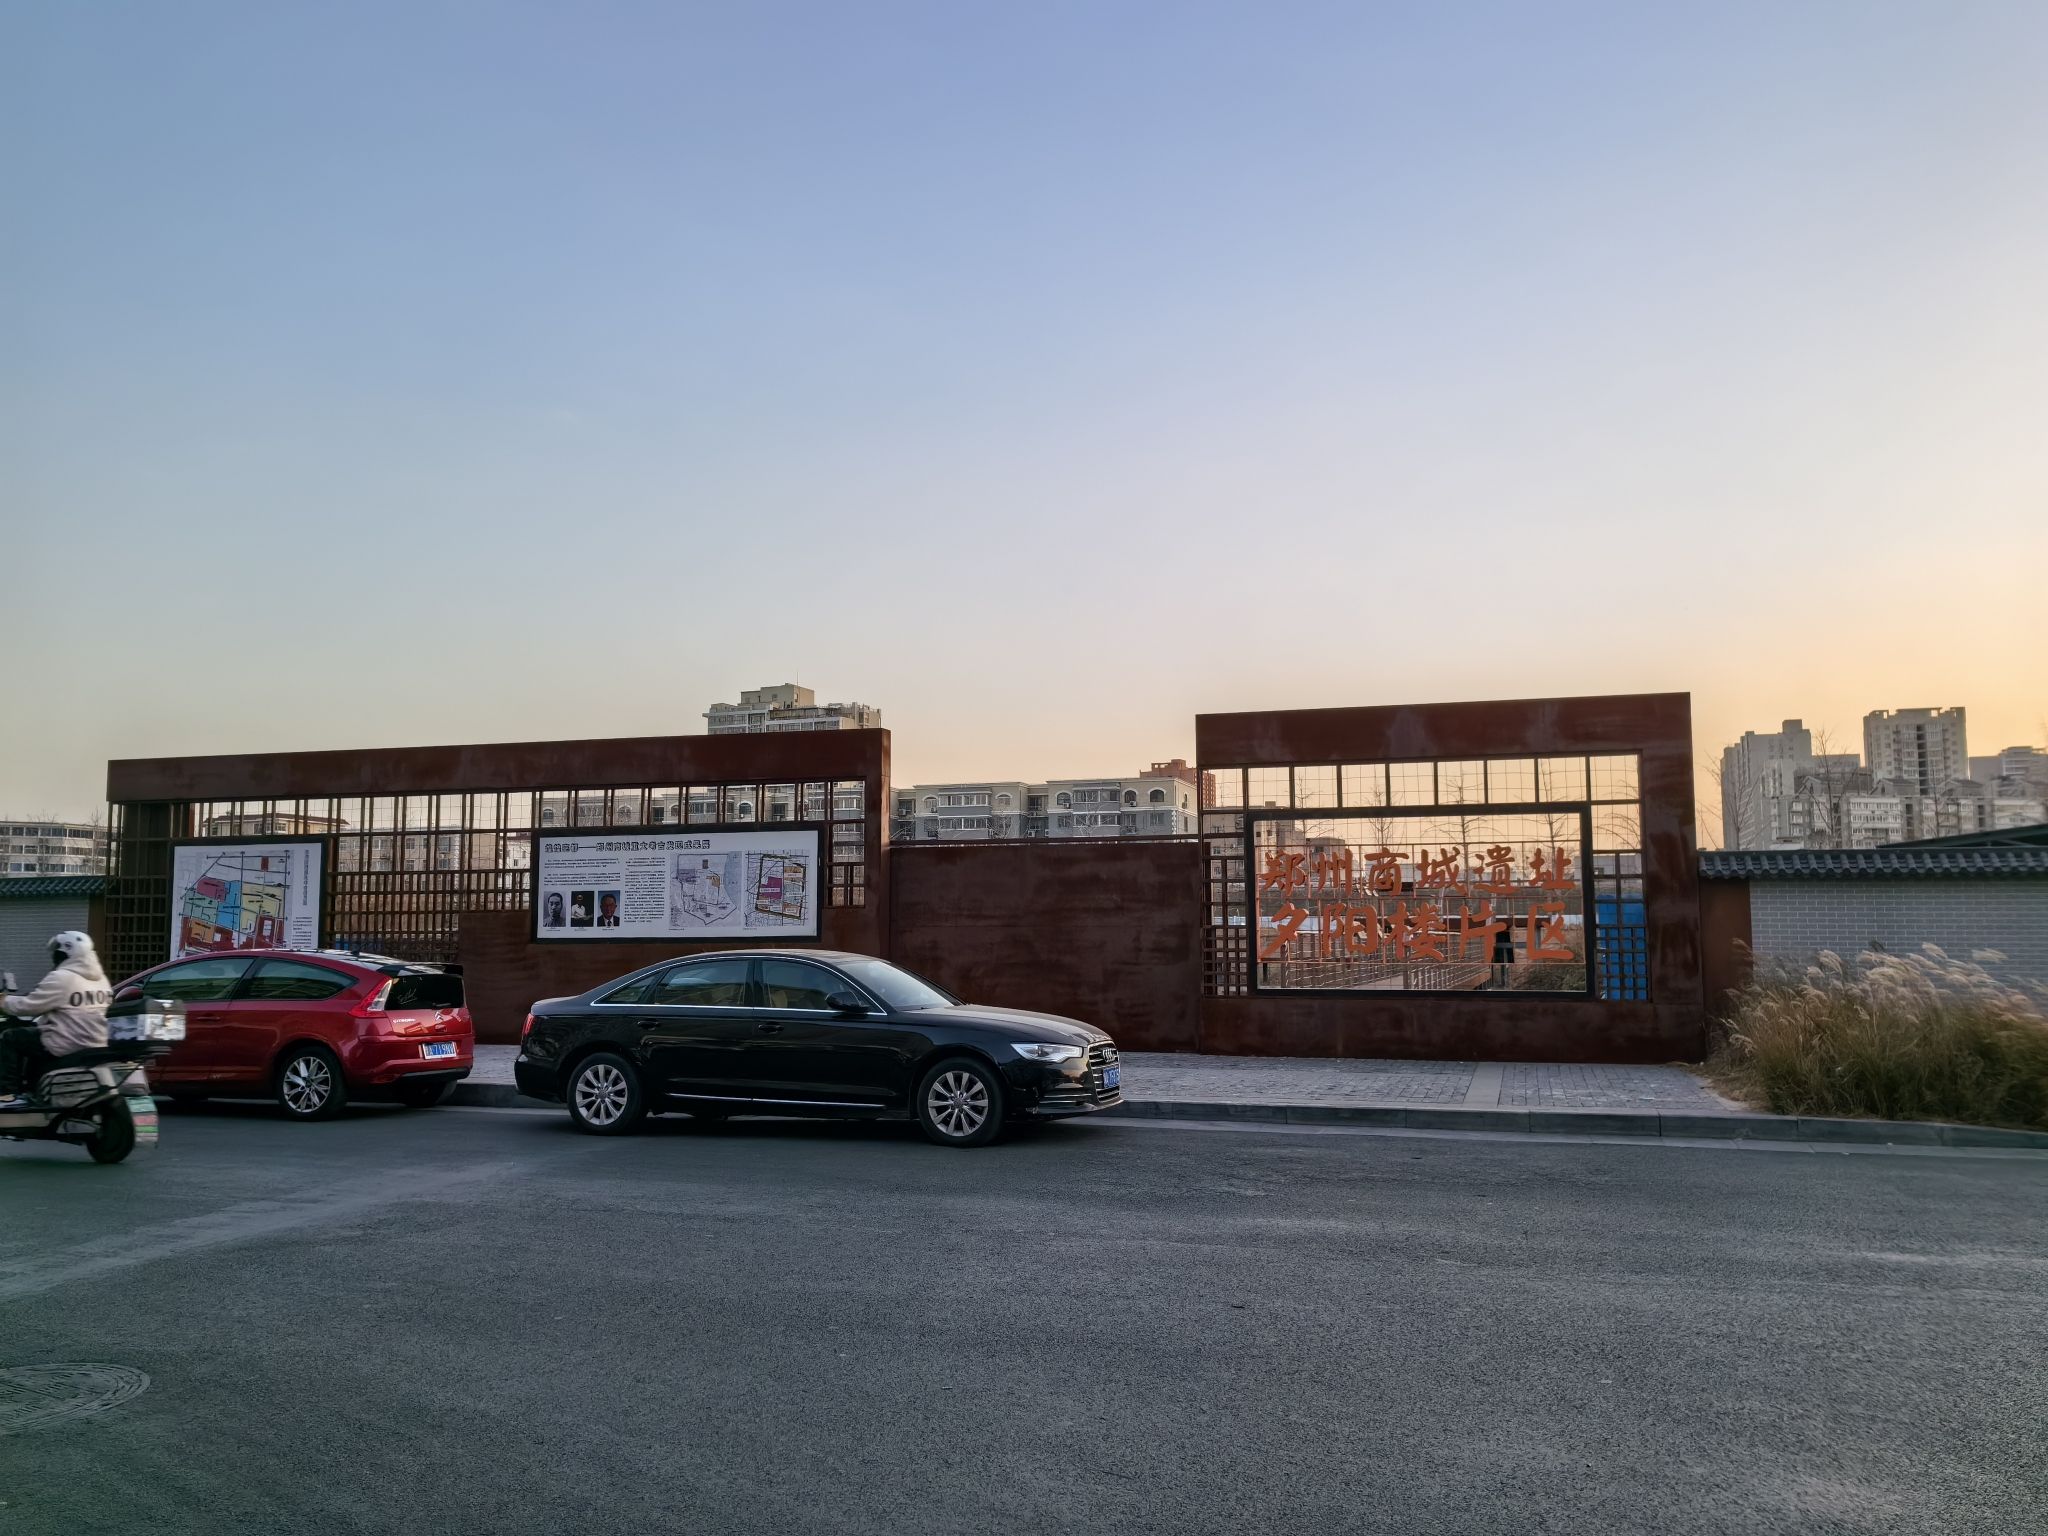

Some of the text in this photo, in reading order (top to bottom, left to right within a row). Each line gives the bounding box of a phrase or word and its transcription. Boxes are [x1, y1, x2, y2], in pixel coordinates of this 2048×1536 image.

[1260, 845, 1576, 897] 郑州商城遗址
[1260, 900, 1575, 964] 夕阳楼片区
